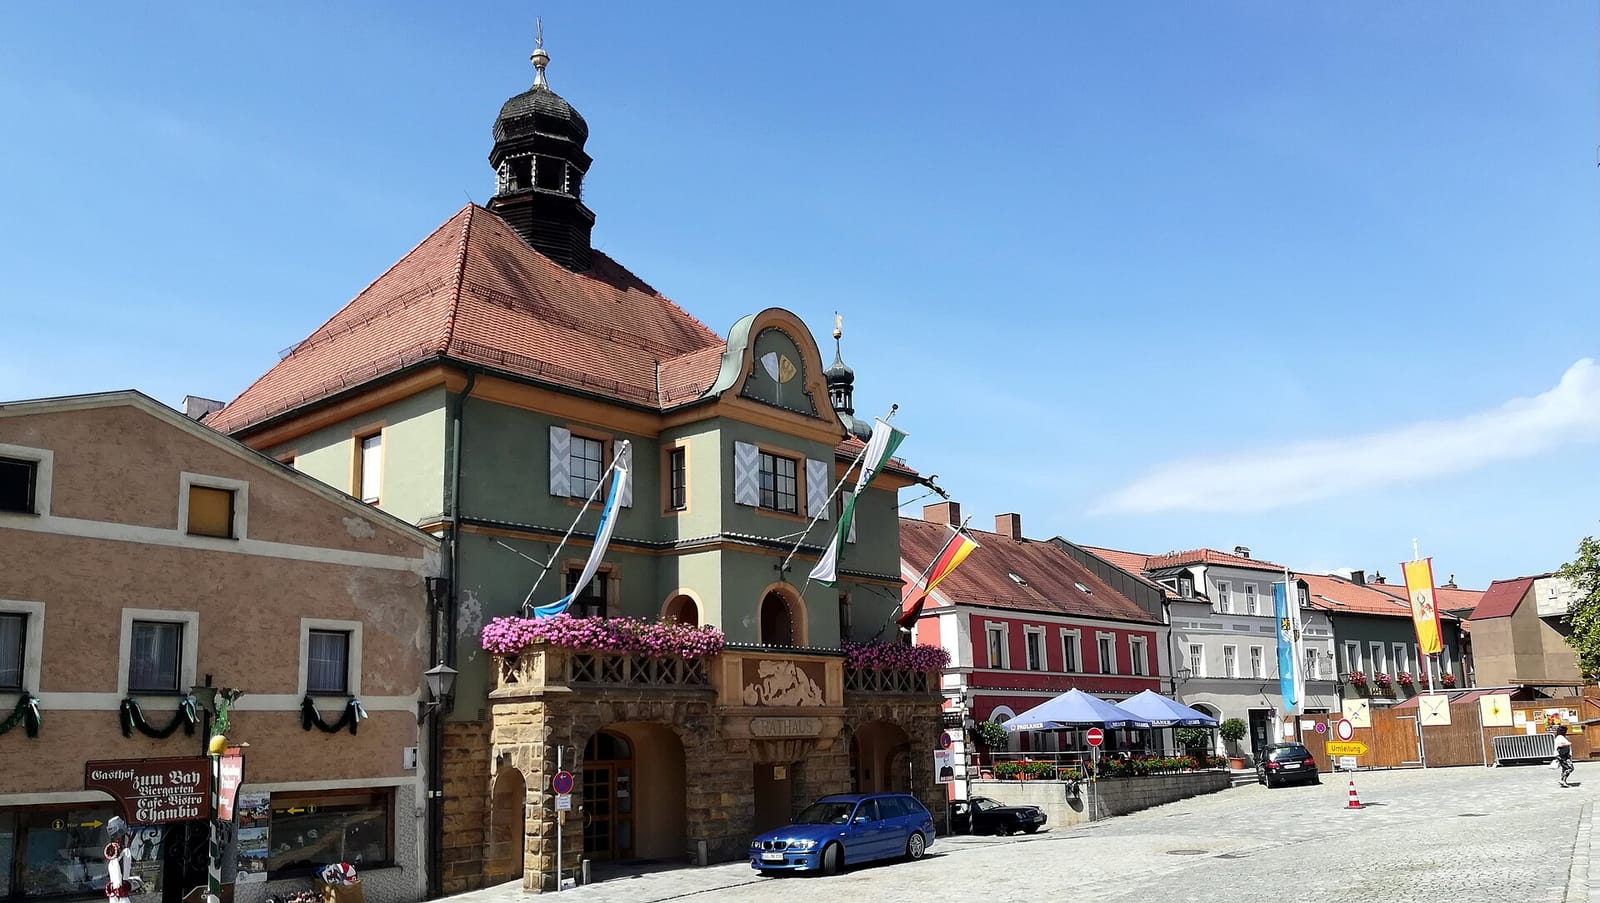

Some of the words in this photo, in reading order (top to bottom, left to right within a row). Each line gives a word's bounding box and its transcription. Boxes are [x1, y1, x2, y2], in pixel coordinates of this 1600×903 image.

[761, 719, 812, 735] RATHAUS
[1331, 745, 1361, 753] Umleitung
[91, 769, 135, 782] Gasthof
[132, 774, 163, 790] zum
[138, 786, 194, 797] Biergarten
[136, 805, 199, 823] Chambio
